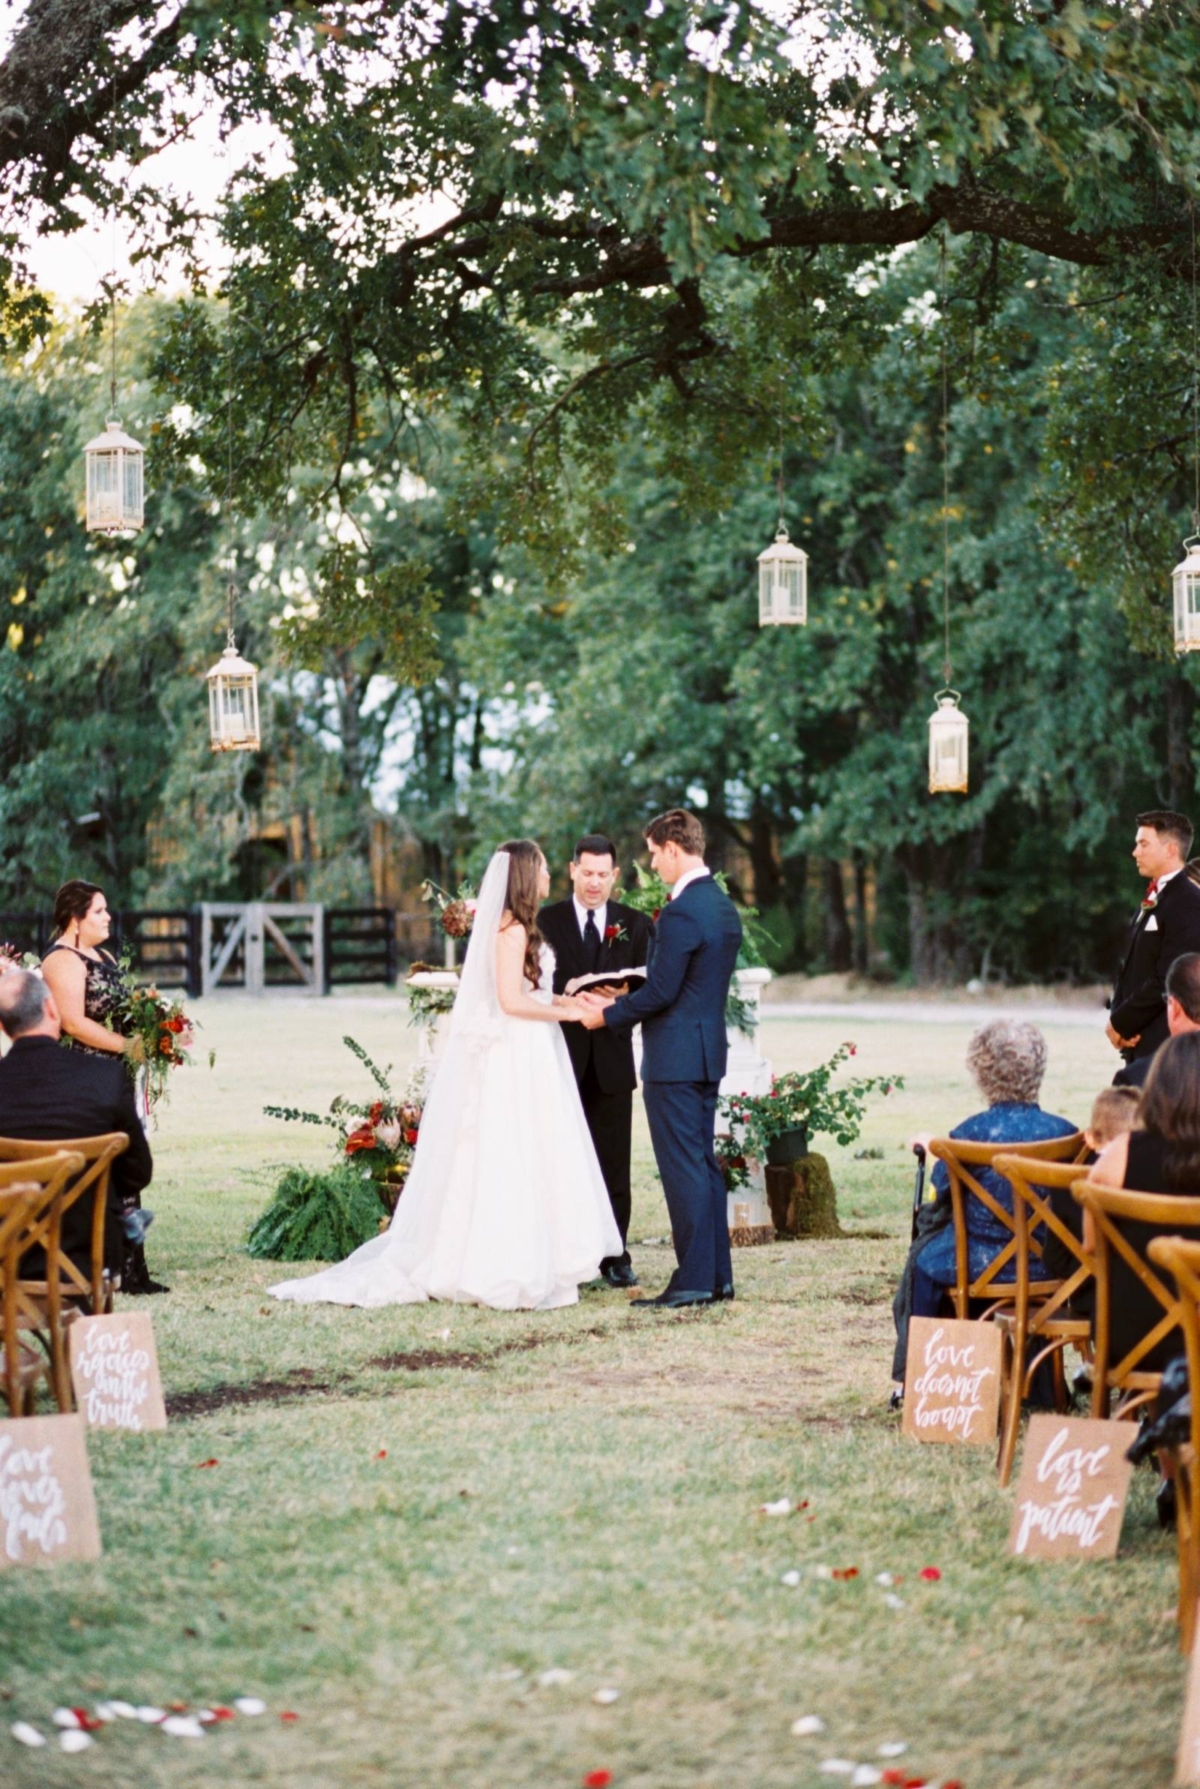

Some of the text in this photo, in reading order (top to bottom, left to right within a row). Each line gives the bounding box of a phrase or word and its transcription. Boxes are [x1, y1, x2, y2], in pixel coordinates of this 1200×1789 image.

[84, 1324, 131, 1354] love
[924, 1327, 976, 1368] love
[82, 1388, 143, 1431] truth
[914, 1395, 985, 1439] boast
[1037, 1427, 1111, 1483] love
[1055, 1468, 1082, 1494] is
[1015, 1494, 1120, 1555] patient
